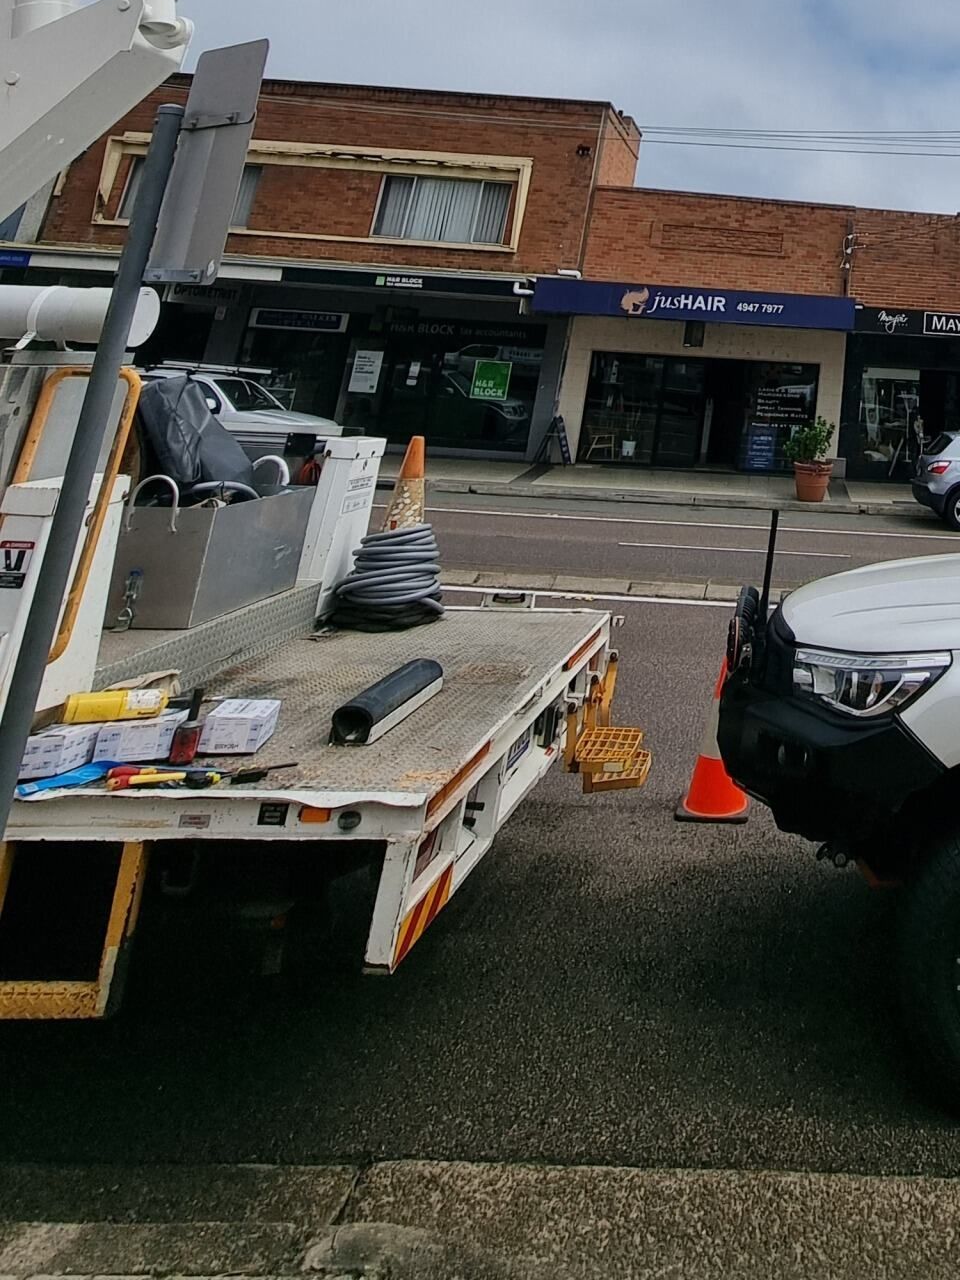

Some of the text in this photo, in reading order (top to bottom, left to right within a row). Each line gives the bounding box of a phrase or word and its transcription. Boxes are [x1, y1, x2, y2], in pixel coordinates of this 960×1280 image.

[647, 292, 784, 314] jusHAIR 4947 7977
[473, 387, 504, 397] BLOCK
